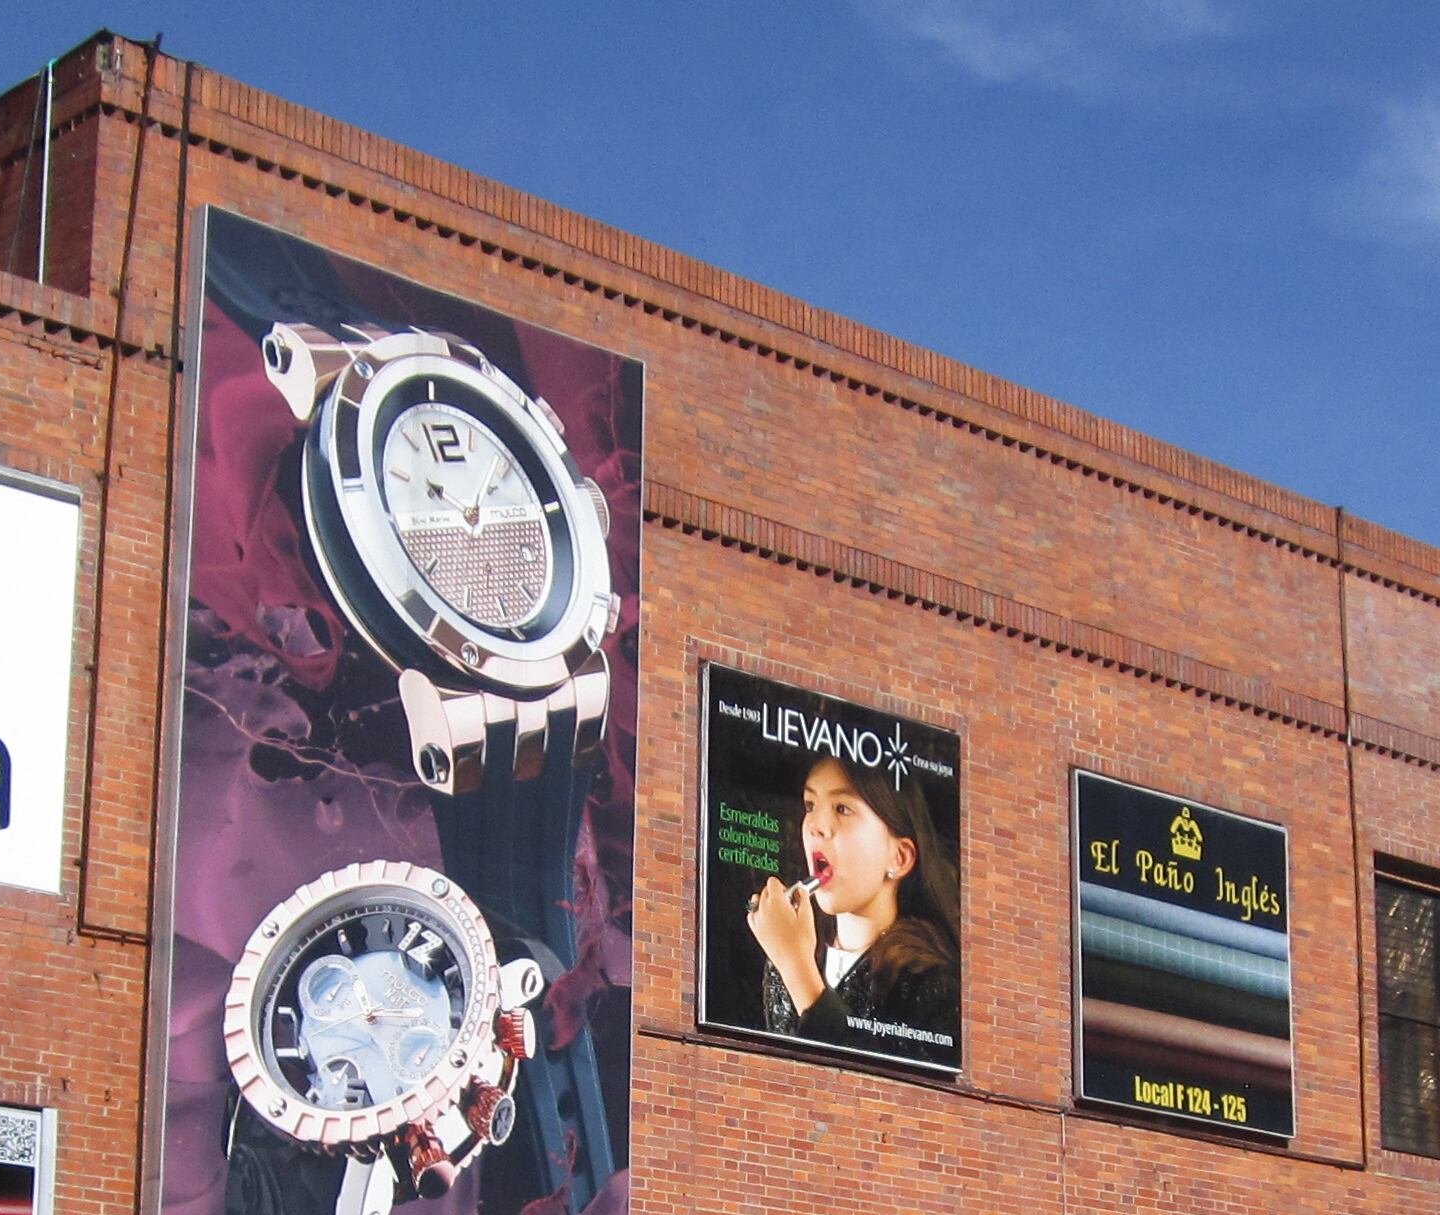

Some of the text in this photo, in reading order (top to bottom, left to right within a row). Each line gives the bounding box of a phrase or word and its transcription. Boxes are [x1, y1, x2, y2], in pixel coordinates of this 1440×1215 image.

[718, 699, 742, 719] Desde
[761, 701, 883, 767] LIEVANO
[718, 801, 781, 834] Esmeraldas
[718, 826, 781, 854] colombianas
[718, 847, 781, 874] certificadas
[1090, 839, 1281, 921] El Paño Inglés
[846, 1013, 954, 1048] www.joyerialievano.com
[1134, 1075, 1174, 1109] Local
[1177, 1085, 1185, 1110] F
[1187, 1086, 1212, 1116] 124
[1221, 1093, 1247, 1124] 125
